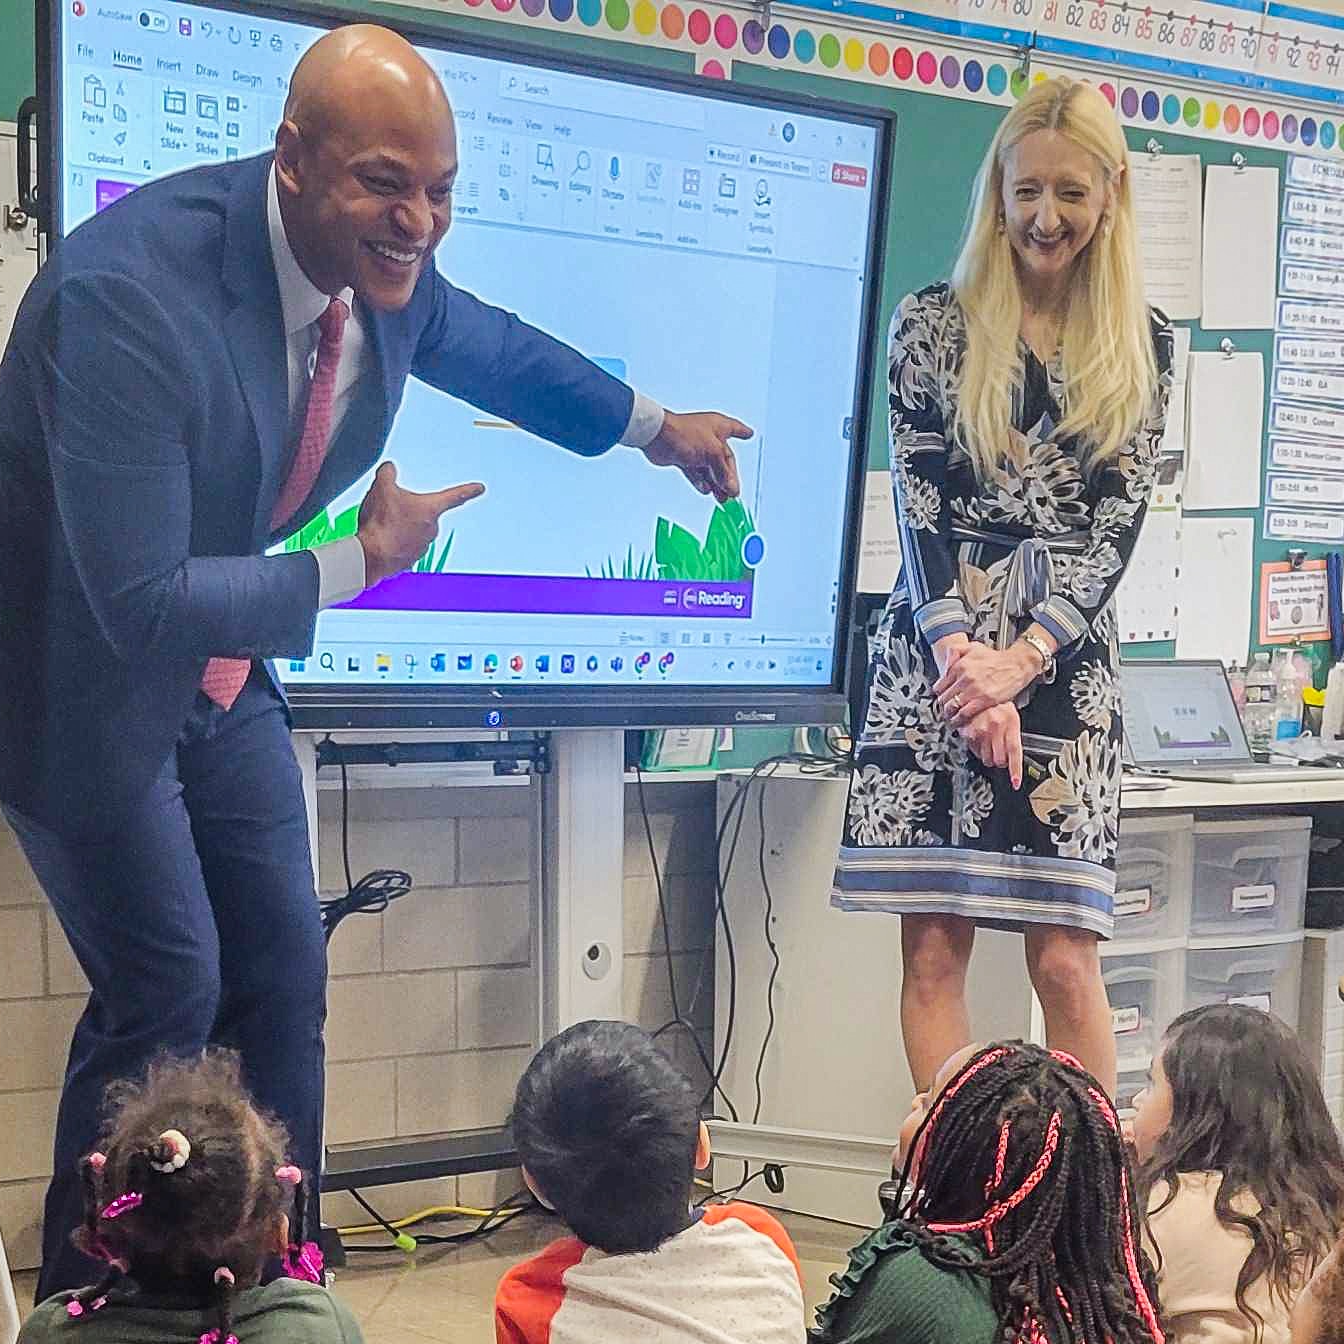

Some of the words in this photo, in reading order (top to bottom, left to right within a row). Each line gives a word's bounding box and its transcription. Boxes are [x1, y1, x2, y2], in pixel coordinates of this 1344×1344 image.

[1112, 14, 1130, 36] 84
[1158, 22, 1176, 44] 86
[1199, 31, 1215, 51] 88
[1241, 38, 1256, 58] 90
[1286, 47, 1302, 68] 92
[77, 43, 94, 57] File
[113, 50, 143, 66] Home
[156, 59, 182, 73] Insert
[195, 63, 220, 79] Draw
[232, 70, 263, 86] Design
[82, 111, 104, 124] Paste
[166, 122, 185, 135] New
[160, 137, 181, 150] Slide
[698, 590, 746, 610] Reading
